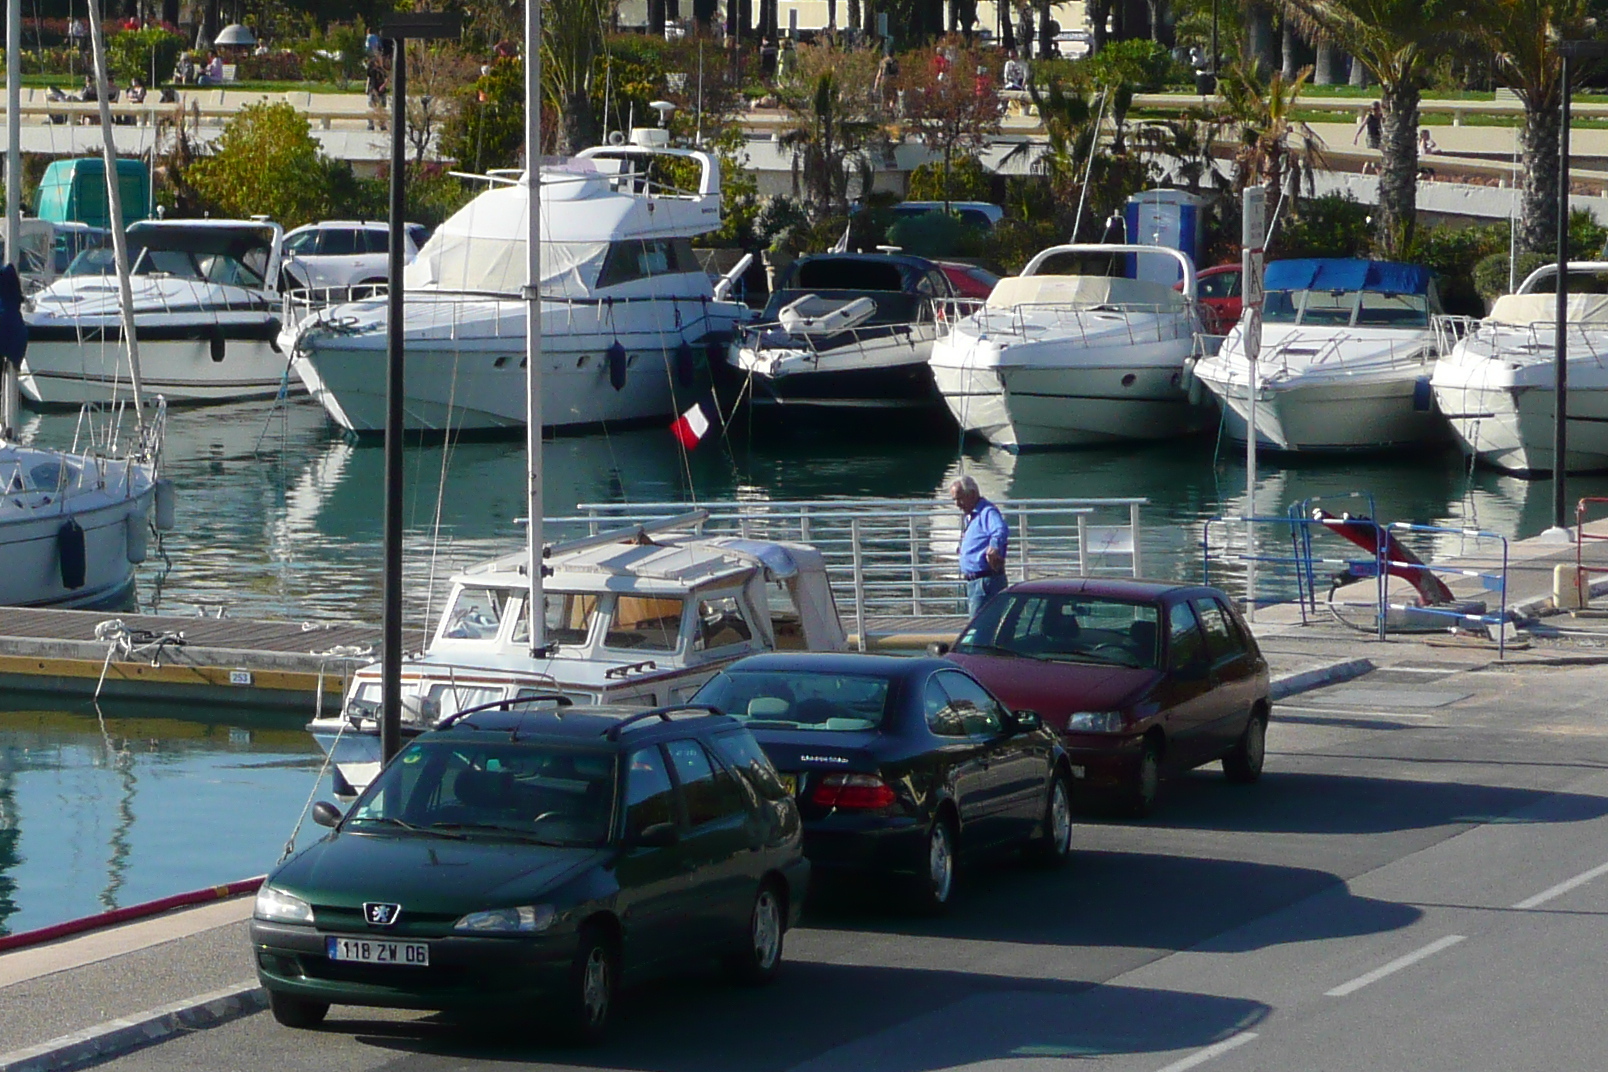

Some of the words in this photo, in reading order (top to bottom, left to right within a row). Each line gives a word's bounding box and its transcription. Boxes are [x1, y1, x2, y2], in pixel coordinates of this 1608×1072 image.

[232, 673, 248, 683] 253
[344, 941, 370, 959] 118
[377, 944, 397, 961] ZW
[405, 945, 425, 963] 06
